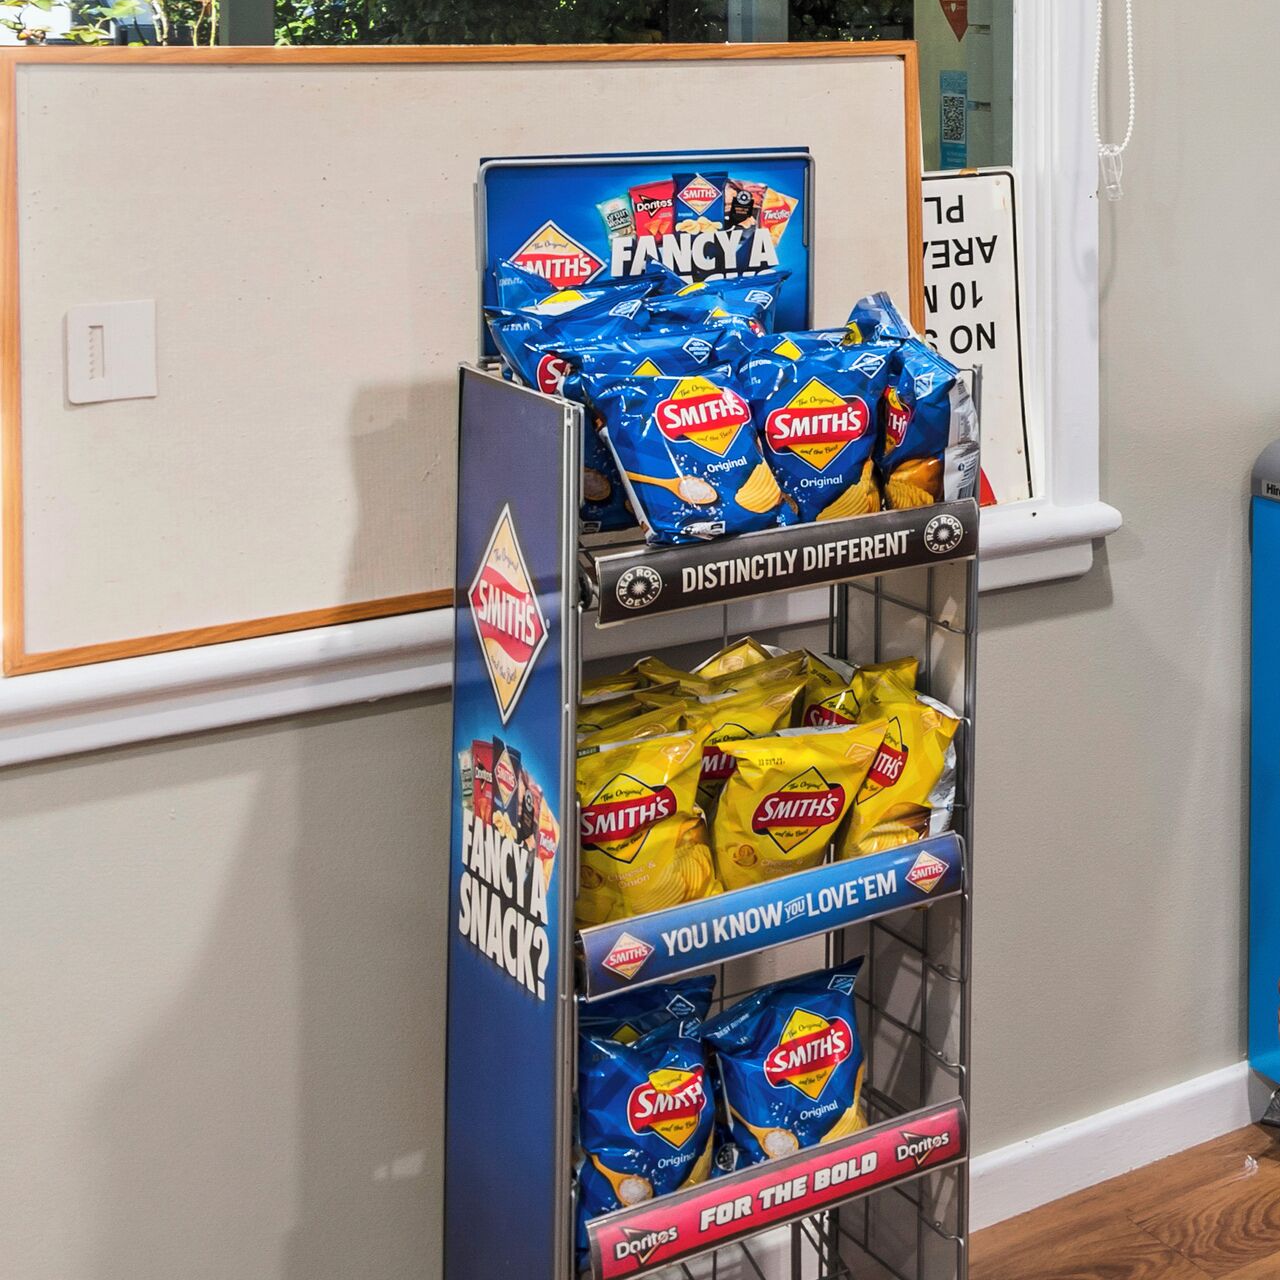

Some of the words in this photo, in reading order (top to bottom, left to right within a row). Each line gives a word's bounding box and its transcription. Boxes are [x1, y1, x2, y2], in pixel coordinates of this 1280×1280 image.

[636, 197, 673, 213] Doritos
[682, 187, 717, 200] SMITH'S
[921, 194, 965, 225] PL
[610, 225, 743, 278] FANCY
[748, 227, 781, 268] A
[949, 280, 983, 311] 10
[949, 321, 996, 354] NO
[678, 386, 691, 398] The
[808, 395, 837, 406] Original
[663, 394, 745, 430] SMITH'S
[772, 406, 863, 440] SMITH'S
[706, 456, 748, 475] Original
[799, 474, 843, 490] Original
[926, 519, 940, 542] RED
[940, 515, 962, 537] ROCK
[931, 540, 955, 553] DELI
[617, 570, 635, 596] RED
[636, 567, 661, 595] ROCK
[682, 549, 798, 594] DISTINCTLY
[477, 578, 537, 647] SMITH'S
[624, 593, 654, 608] DELI
[709, 736, 723, 746] The
[873, 751, 903, 780] ITH'S
[600, 792, 615, 803] The
[615, 787, 644, 800] Original
[788, 780, 799, 790] The
[799, 779, 824, 790] Original
[580, 796, 670, 836] SMITH'S
[757, 793, 839, 823] SMITH'S
[461, 807, 529, 908] FANCY
[529, 856, 549, 926] A
[607, 865, 644, 882] Cheese
[618, 874, 650, 889] Onion
[608, 944, 649, 967] SMITH'S
[661, 925, 709, 957] YOU
[713, 900, 783, 945] KNOW
[784, 899, 806, 920] YOU
[911, 861, 945, 883] SMITH'S
[458, 870, 551, 1002] SNACK?
[785, 1027, 797, 1040] The
[798, 1019, 823, 1034] Original
[770, 1028, 847, 1073] SMITH'S
[799, 1100, 839, 1121] Original
[615, 1225, 679, 1261] Doritos
[699, 1193, 754, 1233] FOR
[758, 1173, 809, 1211] THE
[813, 1151, 879, 1193] BOLD
[896, 1131, 950, 1162] Doritos
